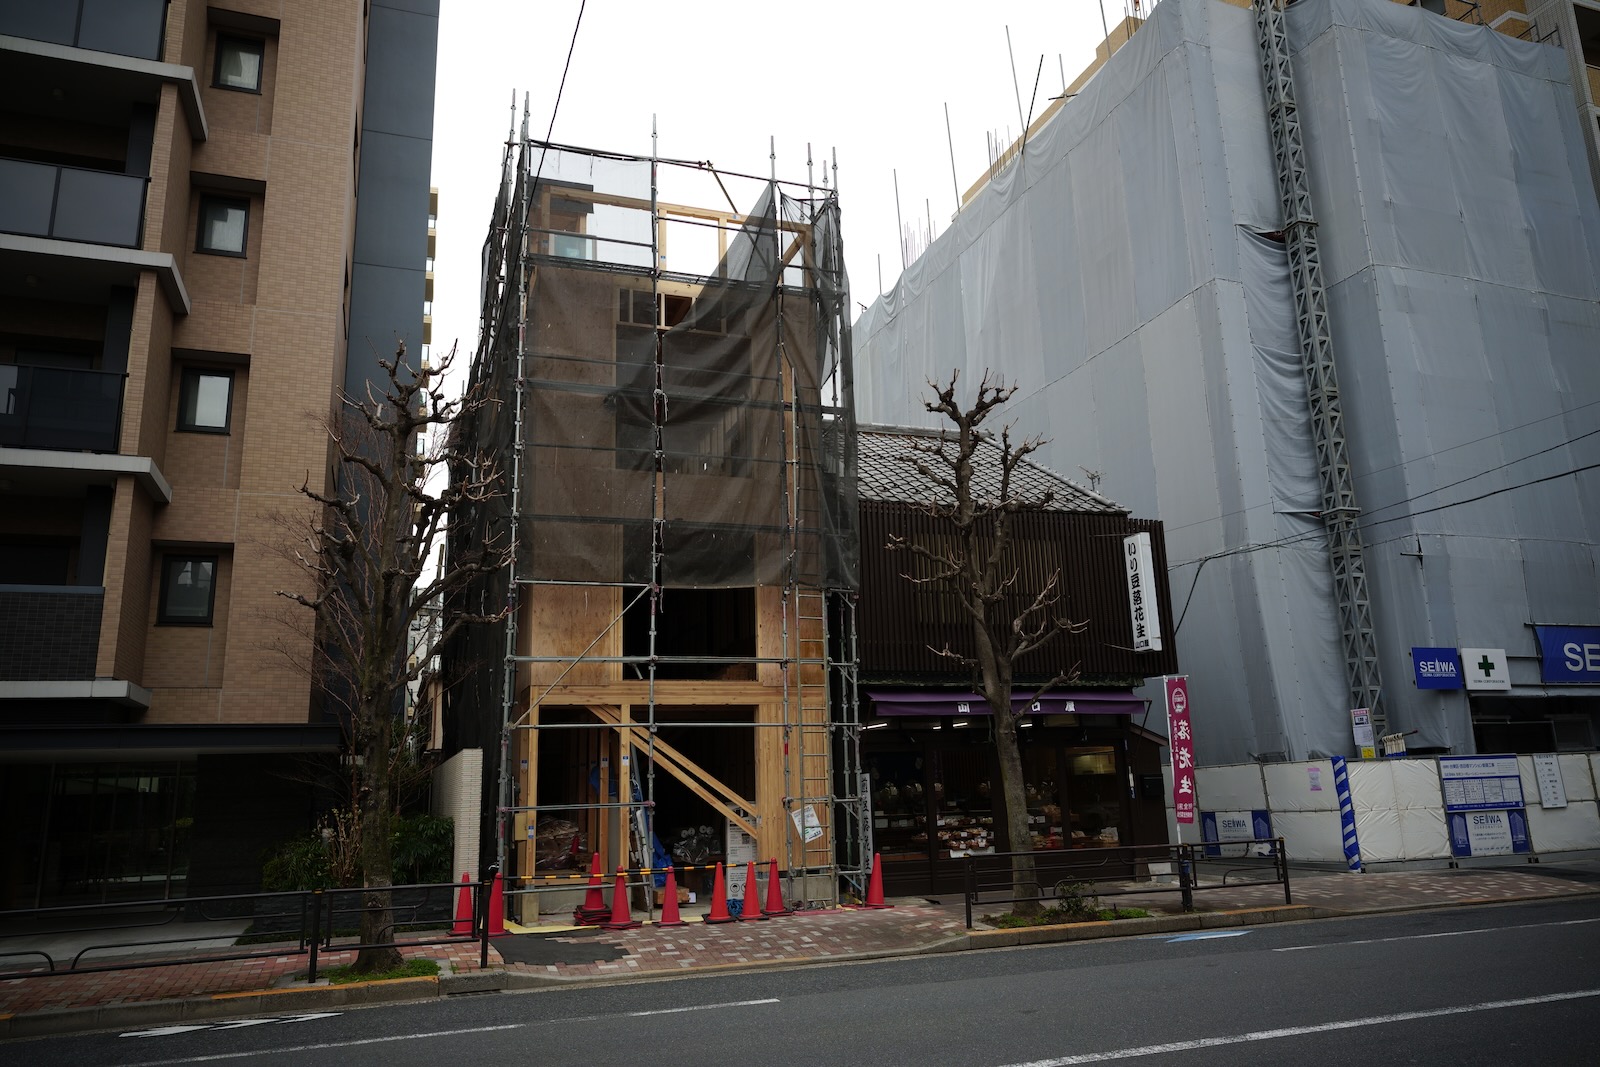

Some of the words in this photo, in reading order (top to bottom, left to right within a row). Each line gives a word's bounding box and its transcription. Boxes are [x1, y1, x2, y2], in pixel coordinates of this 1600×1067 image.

[1128, 542, 1146, 638] いり豆落花生
[1419, 657, 1456, 673] SEIWA
[1222, 818, 1247, 828] SEIWA
[1473, 814, 1502, 825] SEIWA
